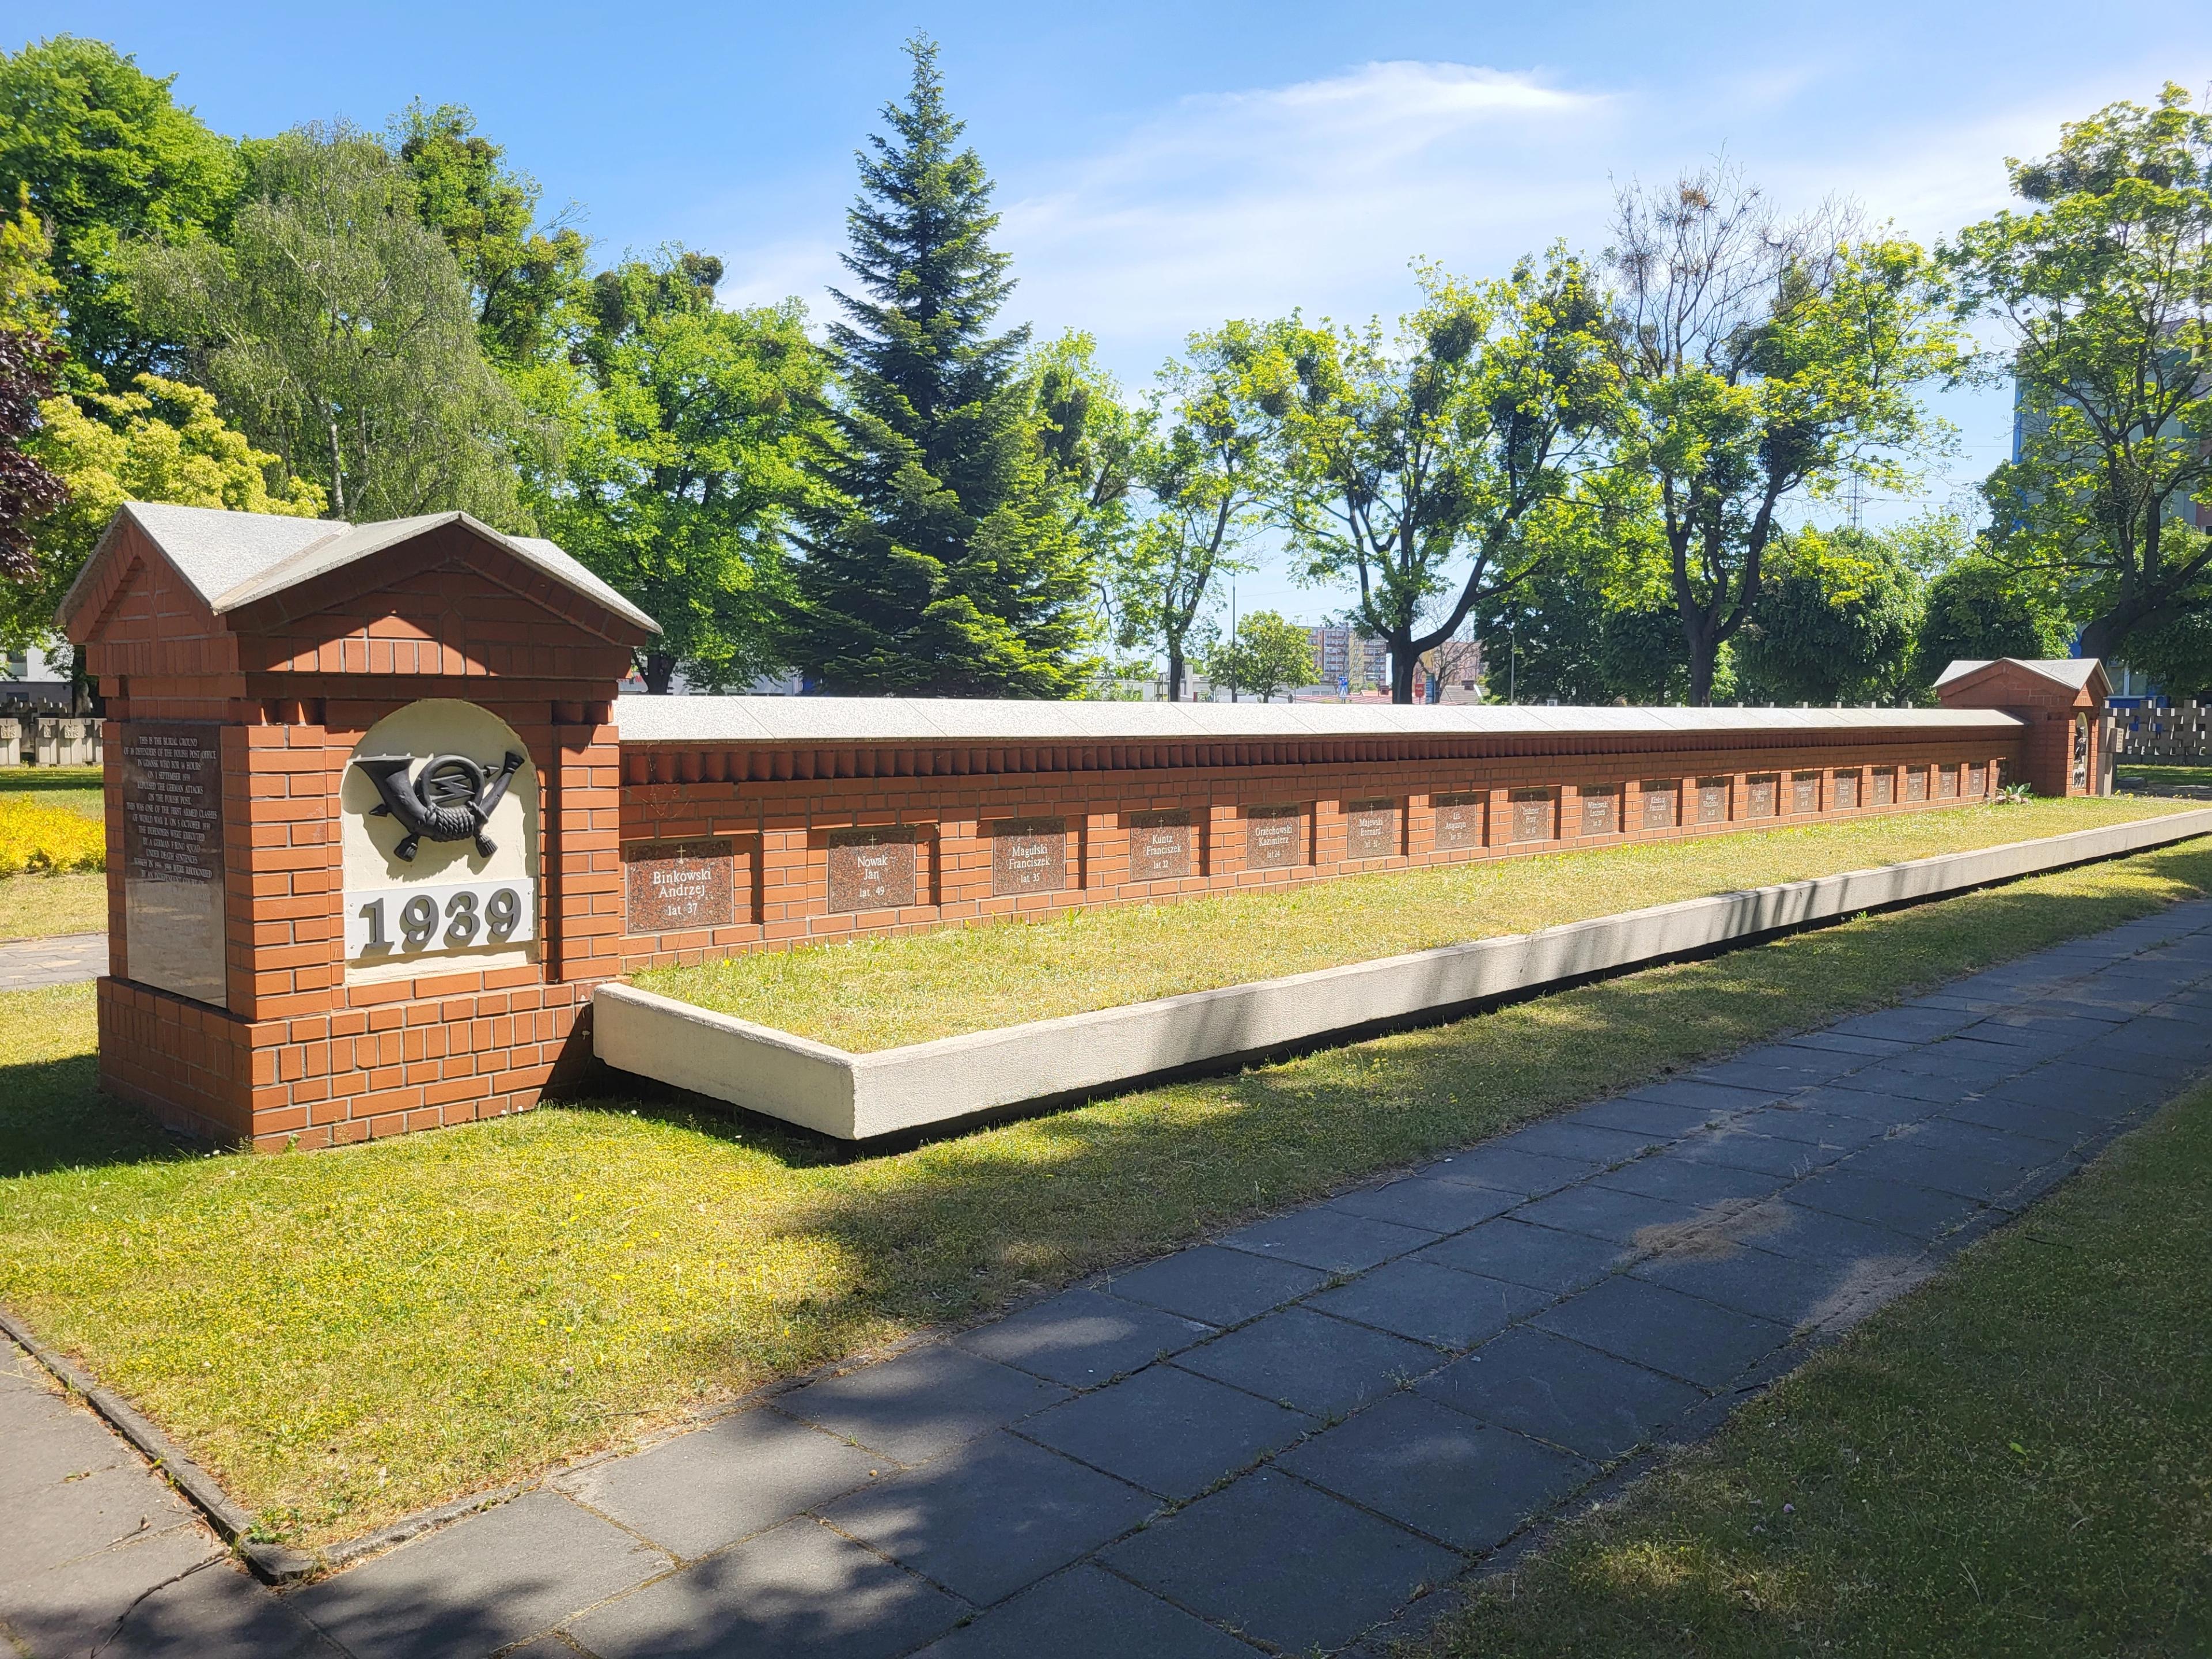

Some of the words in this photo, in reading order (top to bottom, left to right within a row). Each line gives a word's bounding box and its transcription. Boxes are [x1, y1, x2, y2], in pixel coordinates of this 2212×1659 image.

[139, 736, 147, 744] THIS
[163, 737, 177, 745] BURIAL
[179, 738, 198, 747] GROUND
[135, 748, 156, 756] DEFENDERS
[164, 749, 172, 757] THE
[174, 749, 188, 757] POLISH
[190, 750, 200, 758] POST
[202, 751, 216, 759] OFFICE
[160, 760, 169, 768] WHO
[186, 761, 201, 770] HOURS
[158, 771, 181, 781] SEPTEMBER
[137, 781, 156, 790] REPULSED
[166, 783, 183, 792] GERMAN
[185, 785, 203, 794] ATTACKS
[165, 794, 179, 803] POLISH
[127, 802, 135, 810] THIS
[145, 804, 153, 812] ONE
[161, 805, 169, 813] THE
[171, 807, 181, 815] FIRST
[183, 808, 198, 817] ARMED
[199, 809, 217, 819] CLASHES
[138, 815, 153, 823] WORLD
[170, 818, 176, 826] ON
[181, 819, 200, 829] OCTOBER
[1359, 817, 1382, 827] Majewski
[138, 825, 146, 834] THE
[147, 827, 169, 836] DEFENDERS
[170, 830, 181, 838] WERE
[183, 831, 205, 842] EXECUTED
[1255, 824, 1293, 837] Orzechowski
[1361, 827, 1381, 836] Bernard
[154, 839, 170, 848] GERMAN
[172, 842, 185, 850] FRING
[186, 844, 200, 853] SQUAD
[1152, 834, 1173, 846] Kuntz
[1259, 836, 1289, 847] Kazimierz
[146, 849, 160, 858] UNDER
[161, 851, 174, 861] DEATH
[175, 853, 198, 864] SENTENCES
[1012, 844, 1048, 858] Magulski
[1146, 844, 1181, 857] Franciszek
[134, 858, 147, 866] WHICH
[173, 865, 184, 873] WERE
[186, 866, 212, 878] RECOGNIZED
[858, 855, 888, 868] Nowak
[1009, 855, 1051, 869] Franciszek
[1162, 859, 1169, 869] 32
[653, 868, 711, 885] Binkowski
[863, 869, 879, 881] Jan
[1021, 874, 1030, 882] lat
[1033, 873, 1040, 882] 35
[658, 885, 706, 898] Andrzej
[859, 888, 870, 897] lat
[875, 886, 885, 896] 49
[668, 904, 680, 916] lat
[687, 903, 698, 914] 37
[359, 888, 522, 949] 1939
